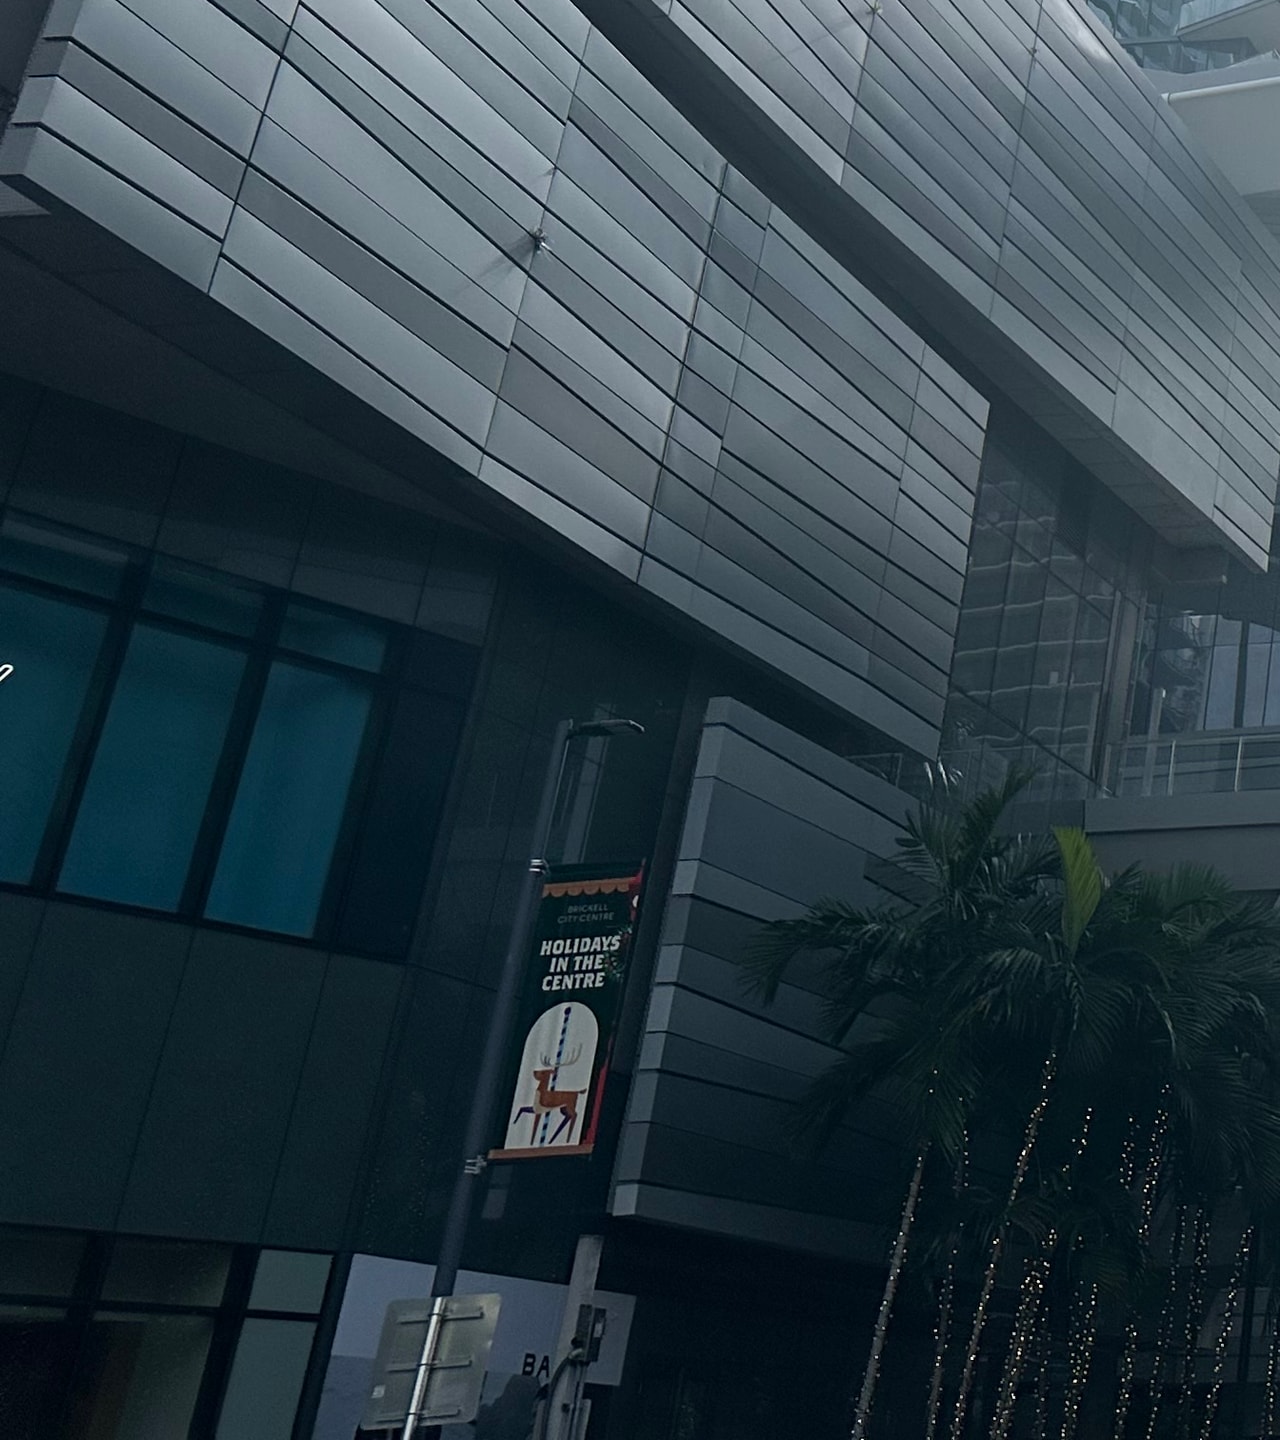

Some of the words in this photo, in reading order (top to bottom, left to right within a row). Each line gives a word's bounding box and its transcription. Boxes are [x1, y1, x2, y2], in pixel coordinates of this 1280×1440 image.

[567, 903, 609, 914] BRICKELL
[579, 912, 615, 923] CENTRE
[540, 935, 621, 956] HOLIDAYS
[549, 956, 570, 973] IN
[573, 954, 605, 971] THE
[541, 972, 606, 991] CENTRE
